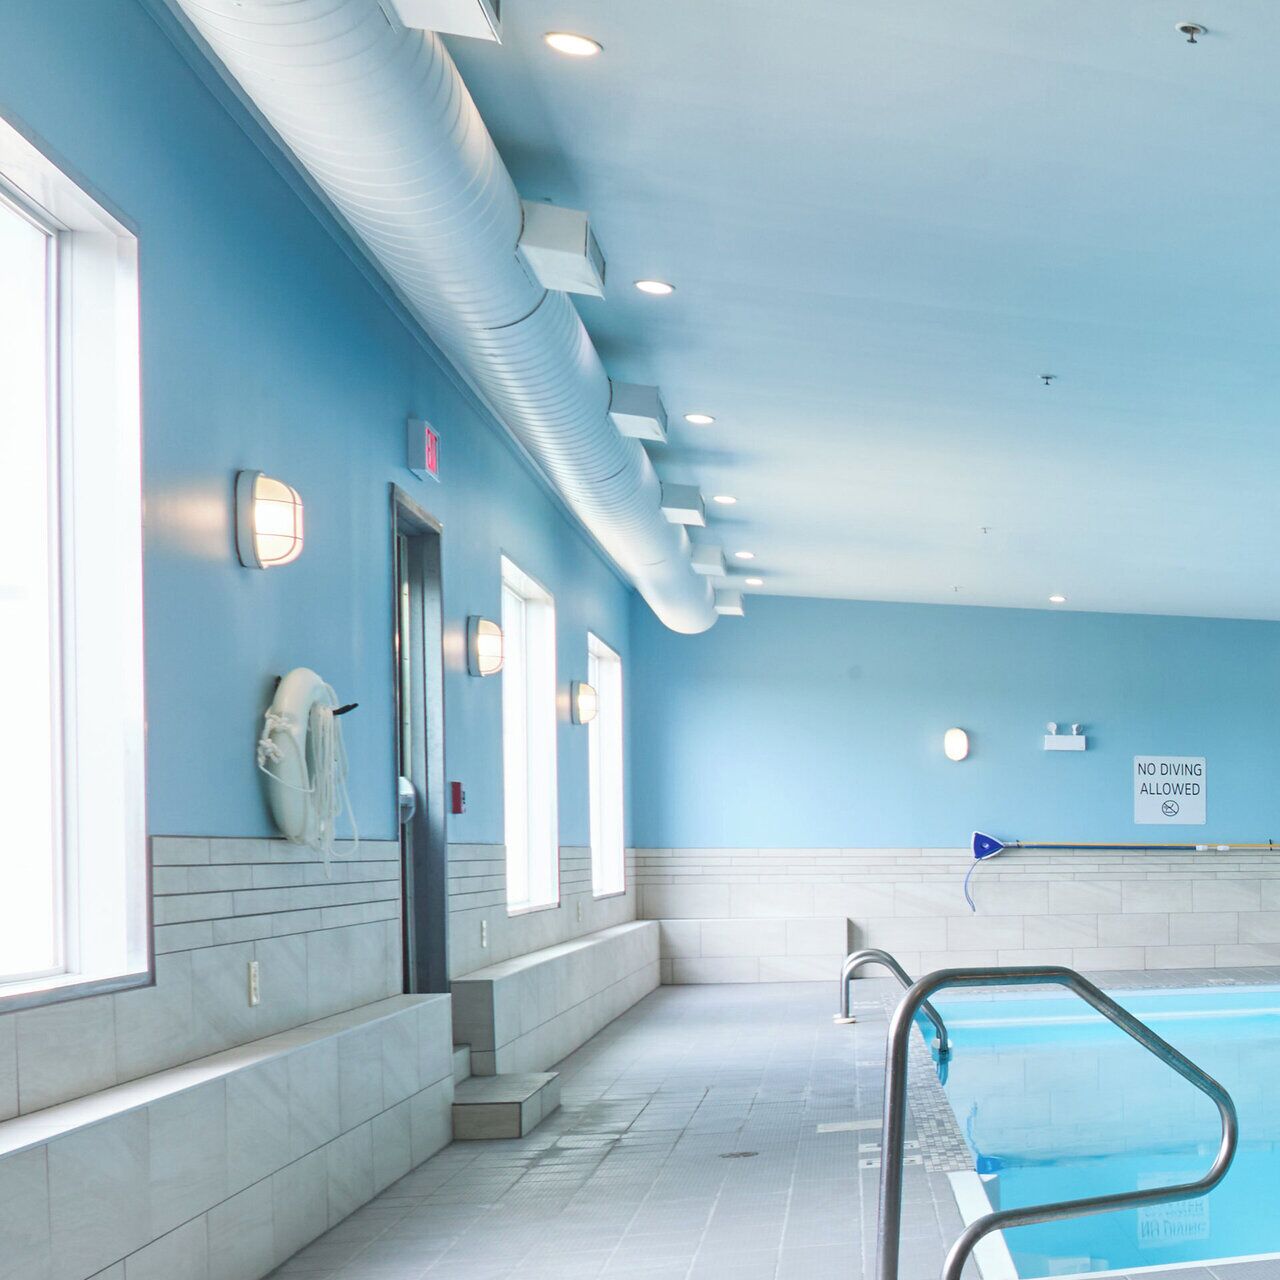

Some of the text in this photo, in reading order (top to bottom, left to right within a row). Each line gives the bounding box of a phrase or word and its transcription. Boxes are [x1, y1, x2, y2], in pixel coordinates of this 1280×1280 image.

[1138, 763, 1202, 777] NO DIVING
[1140, 782, 1200, 796] ALLOWED
